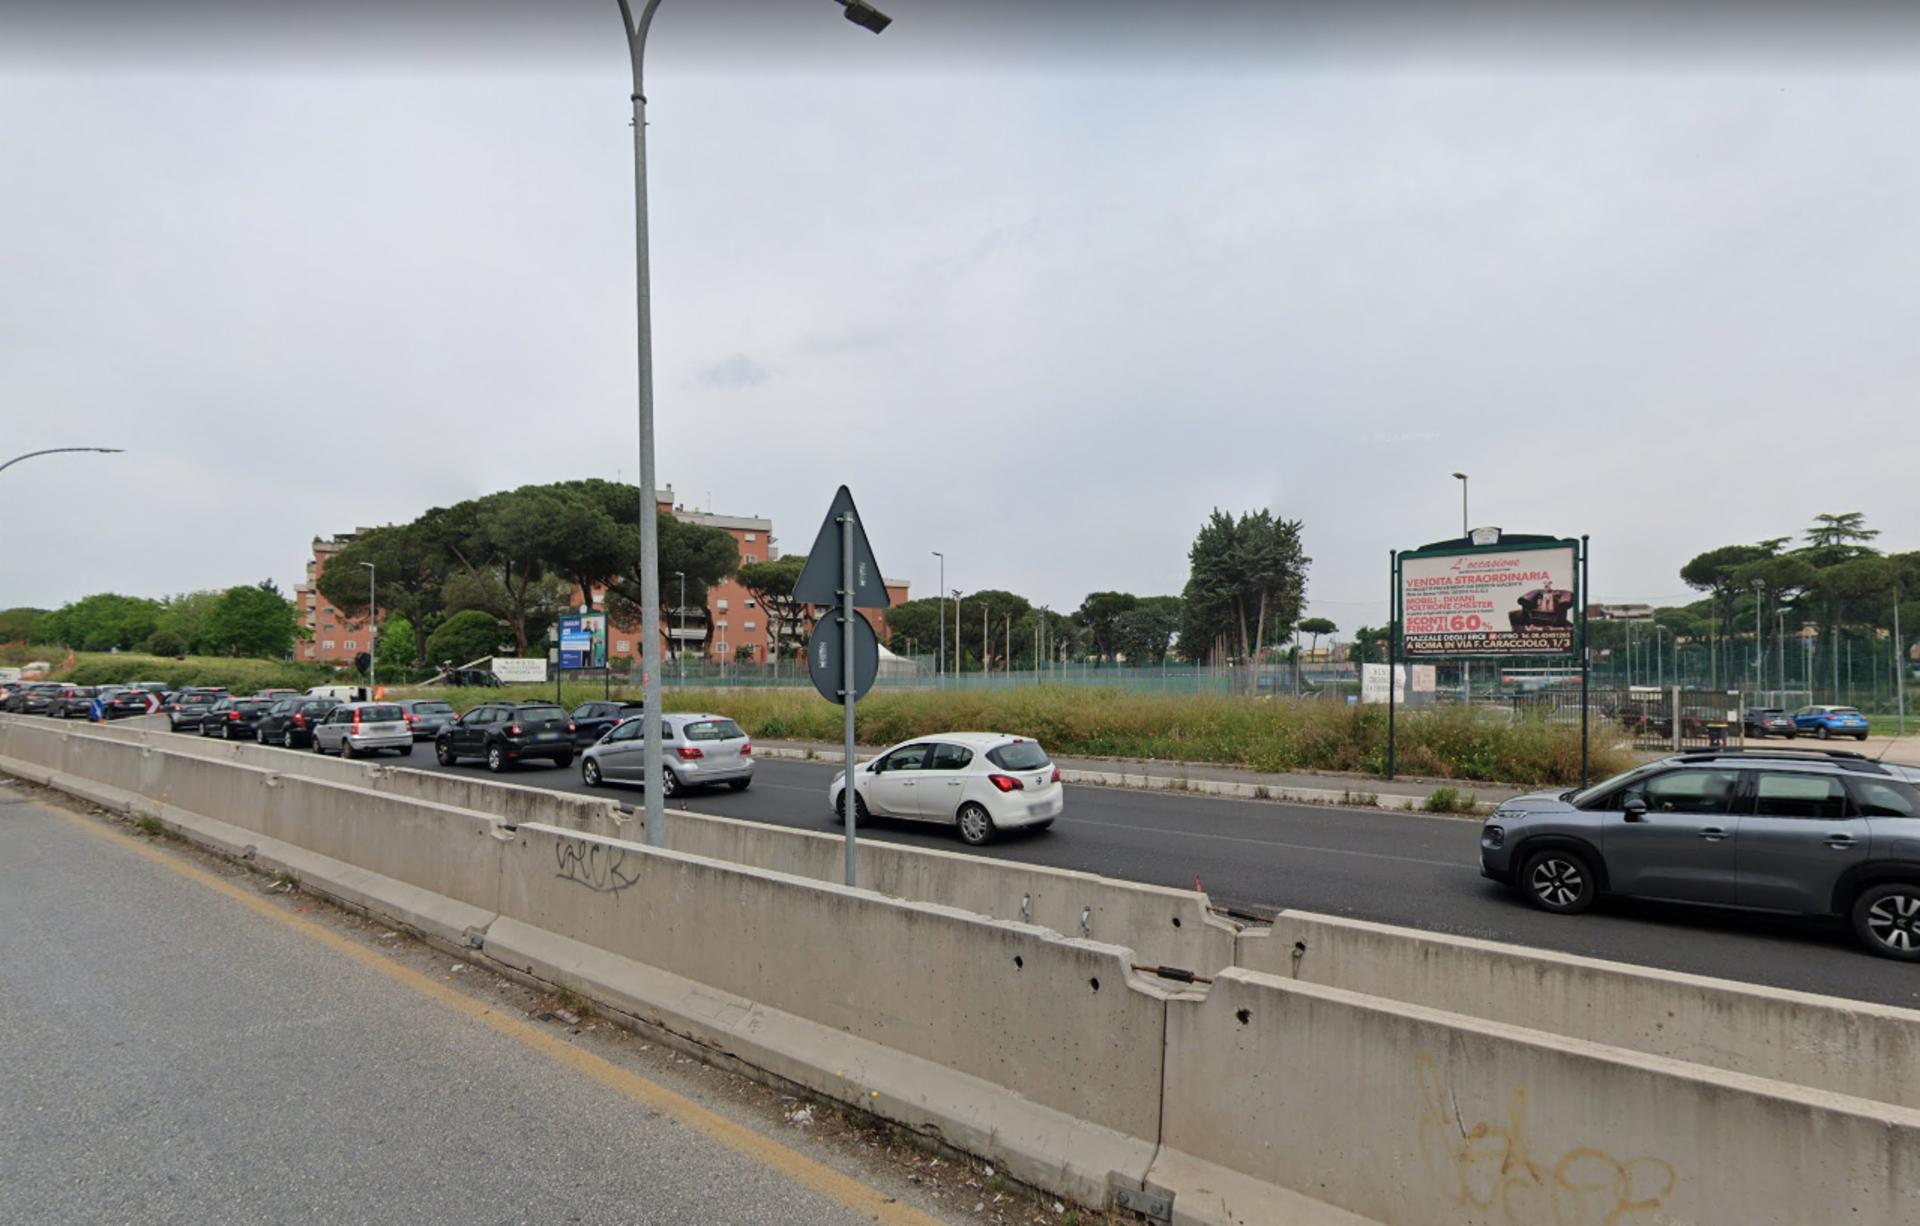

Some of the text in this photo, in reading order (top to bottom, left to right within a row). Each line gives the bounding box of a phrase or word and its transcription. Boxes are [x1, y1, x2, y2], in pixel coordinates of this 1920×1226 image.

[1407, 576, 1453, 588] VENDITA
[1455, 570, 1550, 585] STRAORDINARIA
[1407, 601, 1493, 611] POLTRONE CHESTER
[1407, 616, 1448, 625] SCONTI
[1407, 623, 1450, 633] FINO AL
[1406, 634, 1441, 642] PIAZZALE
[1406, 638, 1571, 649] A ROMA IN VIA F. CARACCIOLO, 1/3
